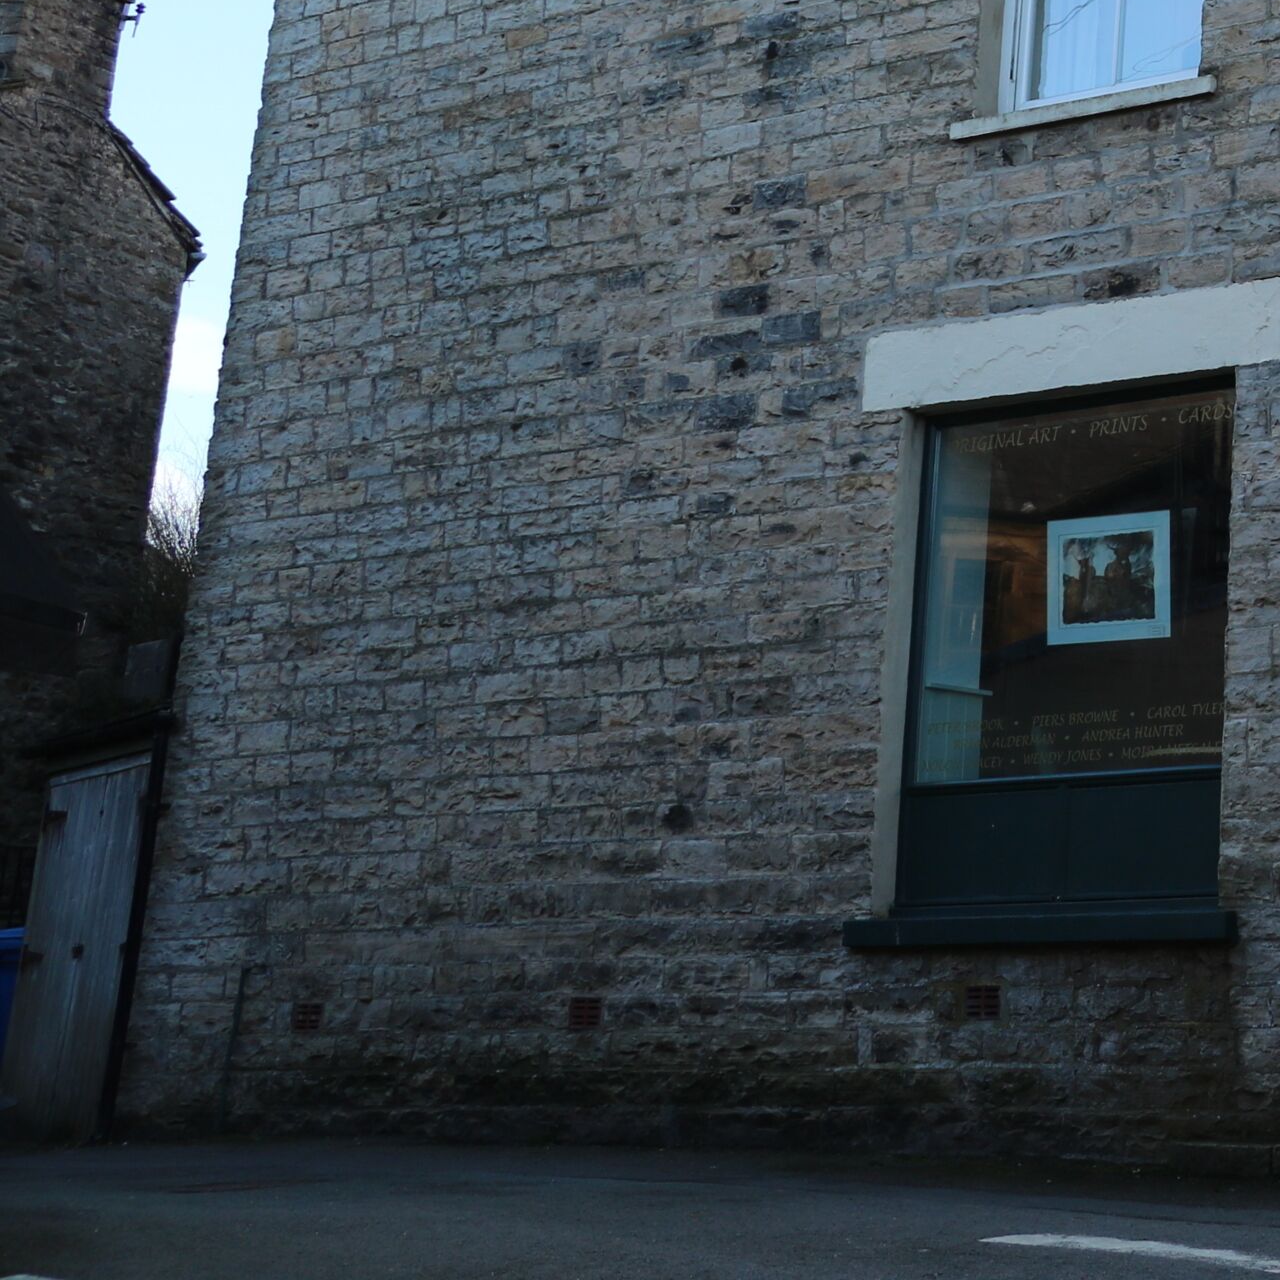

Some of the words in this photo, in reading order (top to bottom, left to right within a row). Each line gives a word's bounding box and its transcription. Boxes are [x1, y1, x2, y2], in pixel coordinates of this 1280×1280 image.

[952, 429, 1024, 454] ORIGINAL
[1028, 424, 1063, 446] ART
[1088, 413, 1150, 439] PRINTS
[1177, 403, 1233, 425] CARDS
[1032, 712, 1065, 728] PIERS
[1068, 708, 1120, 725] BROWNE
[1146, 703, 1187, 720] CAROL
[1191, 701, 1226, 717] TYLER
[1081, 727, 1131, 742] ANDREA
[1134, 723, 1185, 739] HUNTER
[1023, 751, 1064, 766] WENDY
[1064, 748, 1102, 765] JONES
